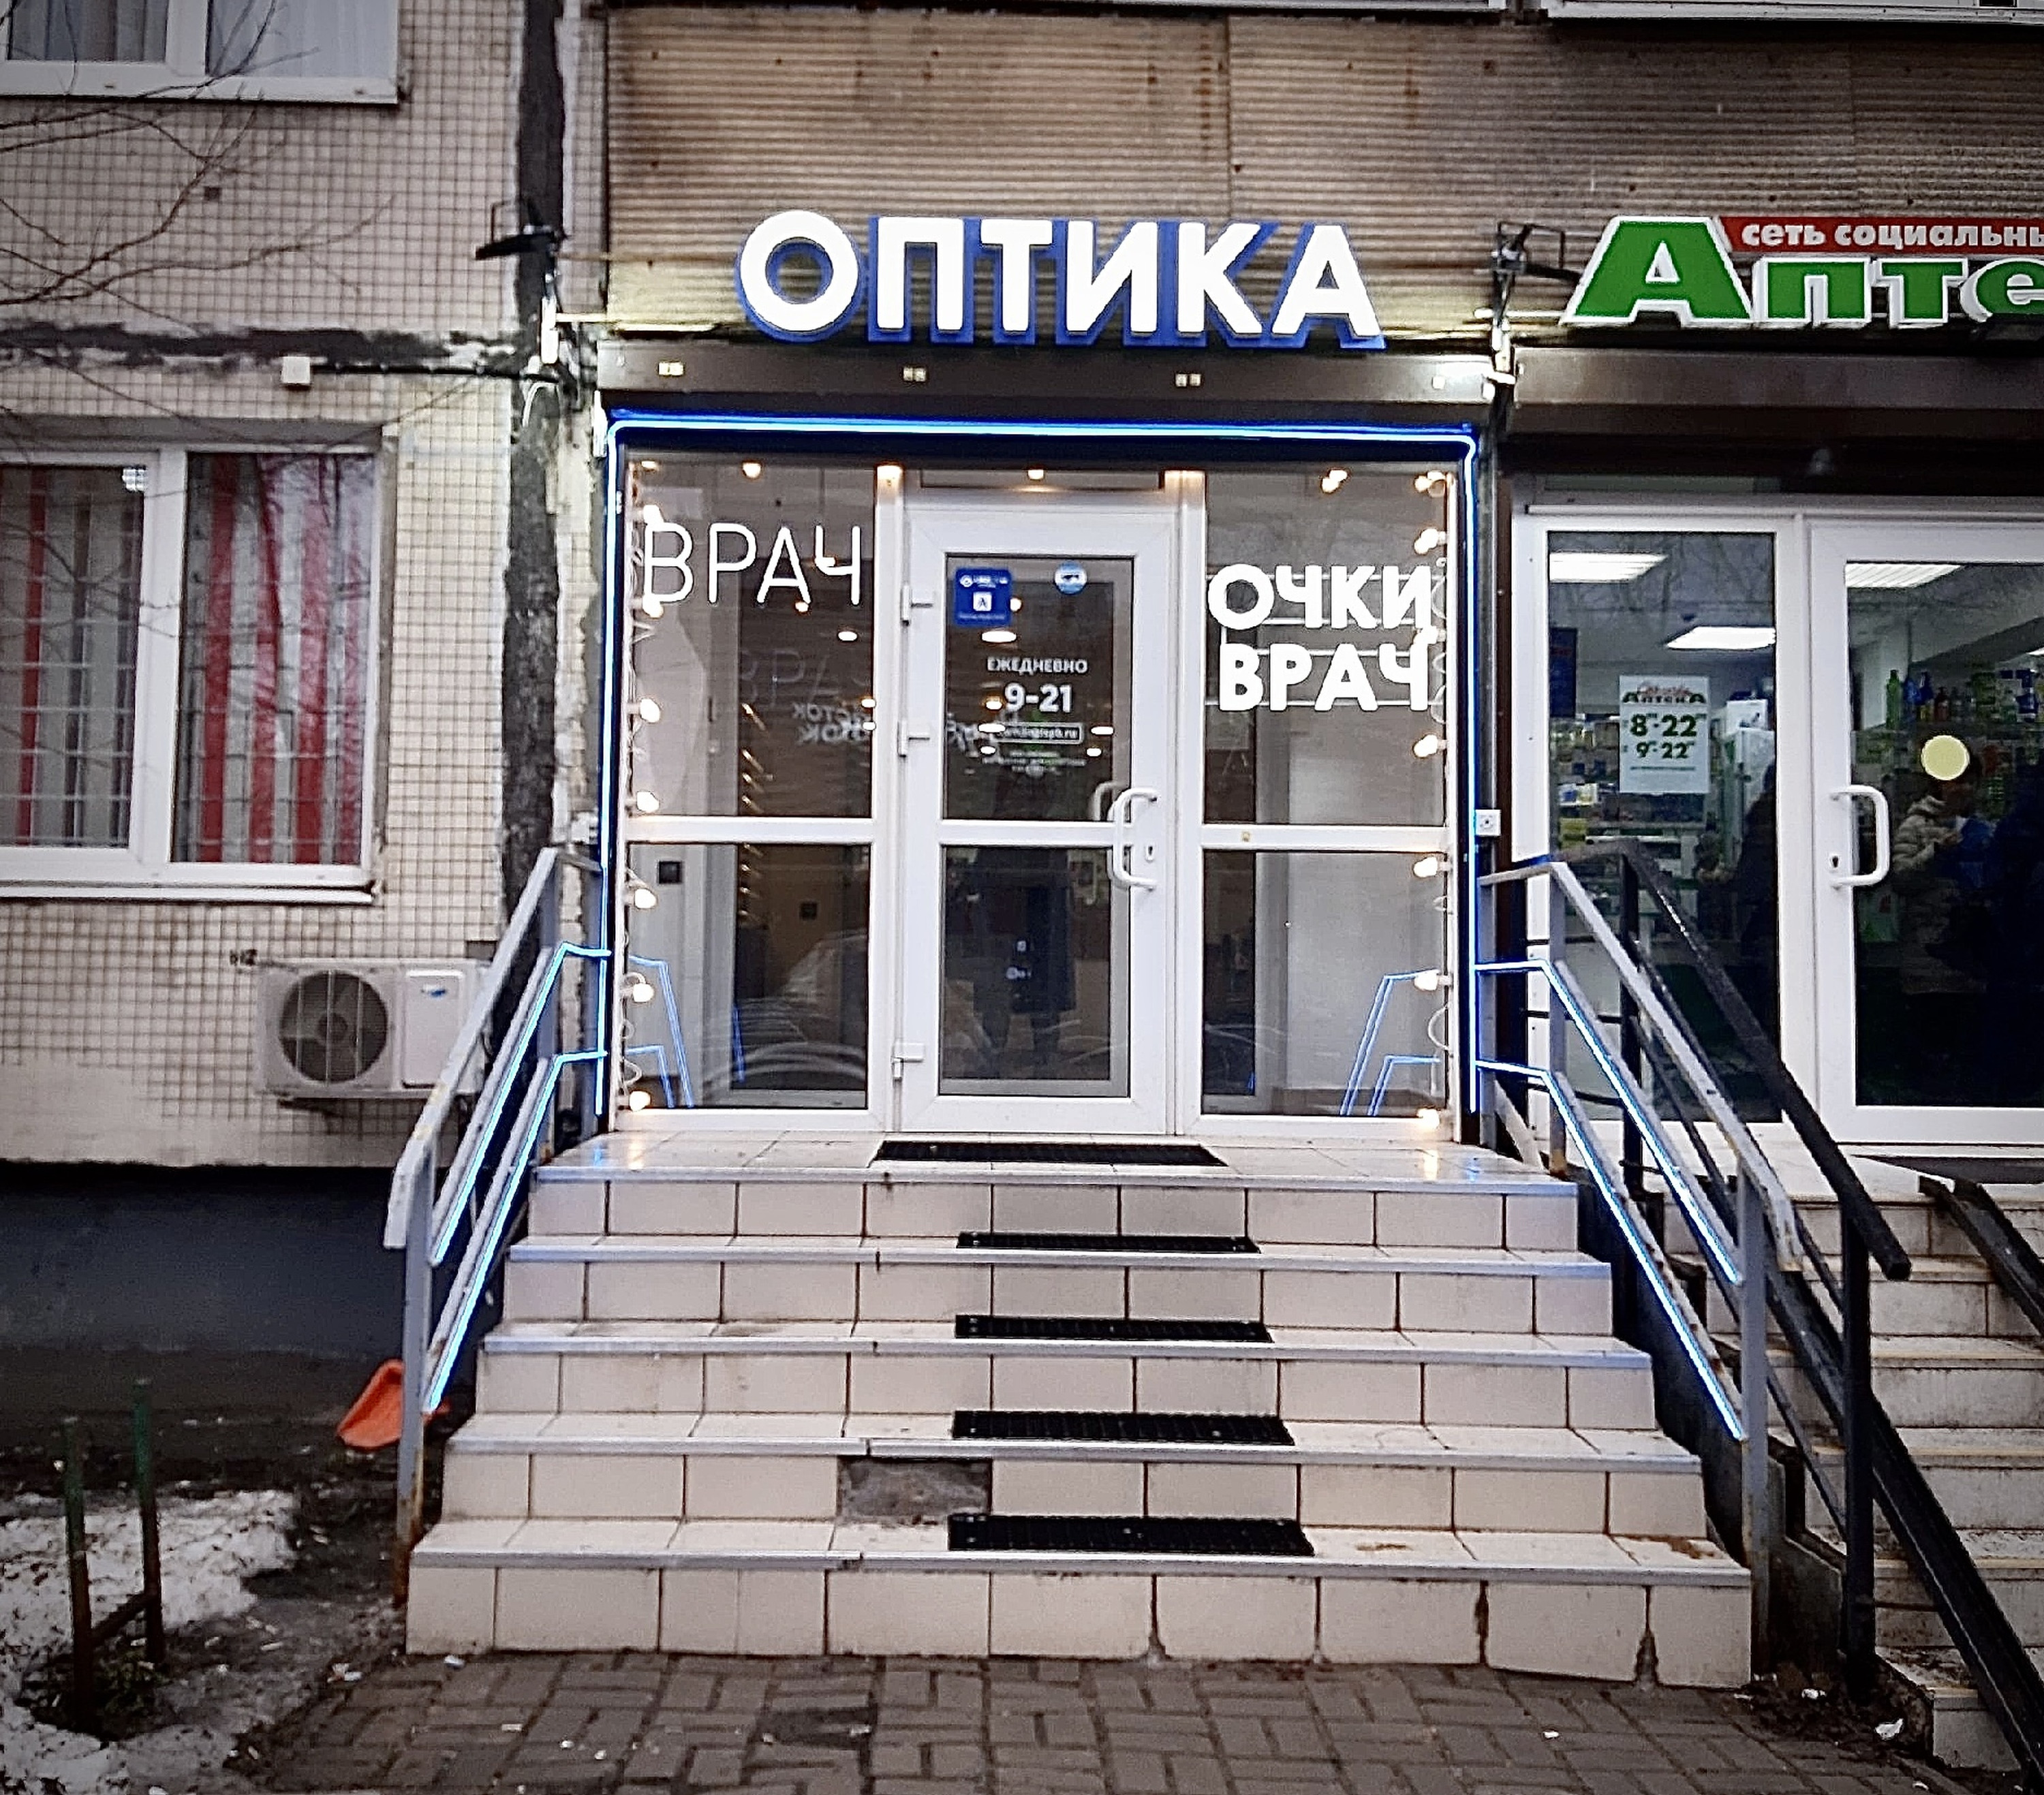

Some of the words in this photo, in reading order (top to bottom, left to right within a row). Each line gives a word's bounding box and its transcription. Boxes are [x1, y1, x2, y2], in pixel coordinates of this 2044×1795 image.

[1741, 223, 1826, 247] сеть
[738, 210, 1386, 345] ОПТИКА
[643, 522, 861, 605] ВРАЧ
[1207, 563, 1432, 631] ОЧКИ
[987, 657, 1089, 676] ЕЖЕДНЕВНО
[1004, 682, 1073, 713] 9-21
[1218, 642, 1429, 712] ВРАЧ
